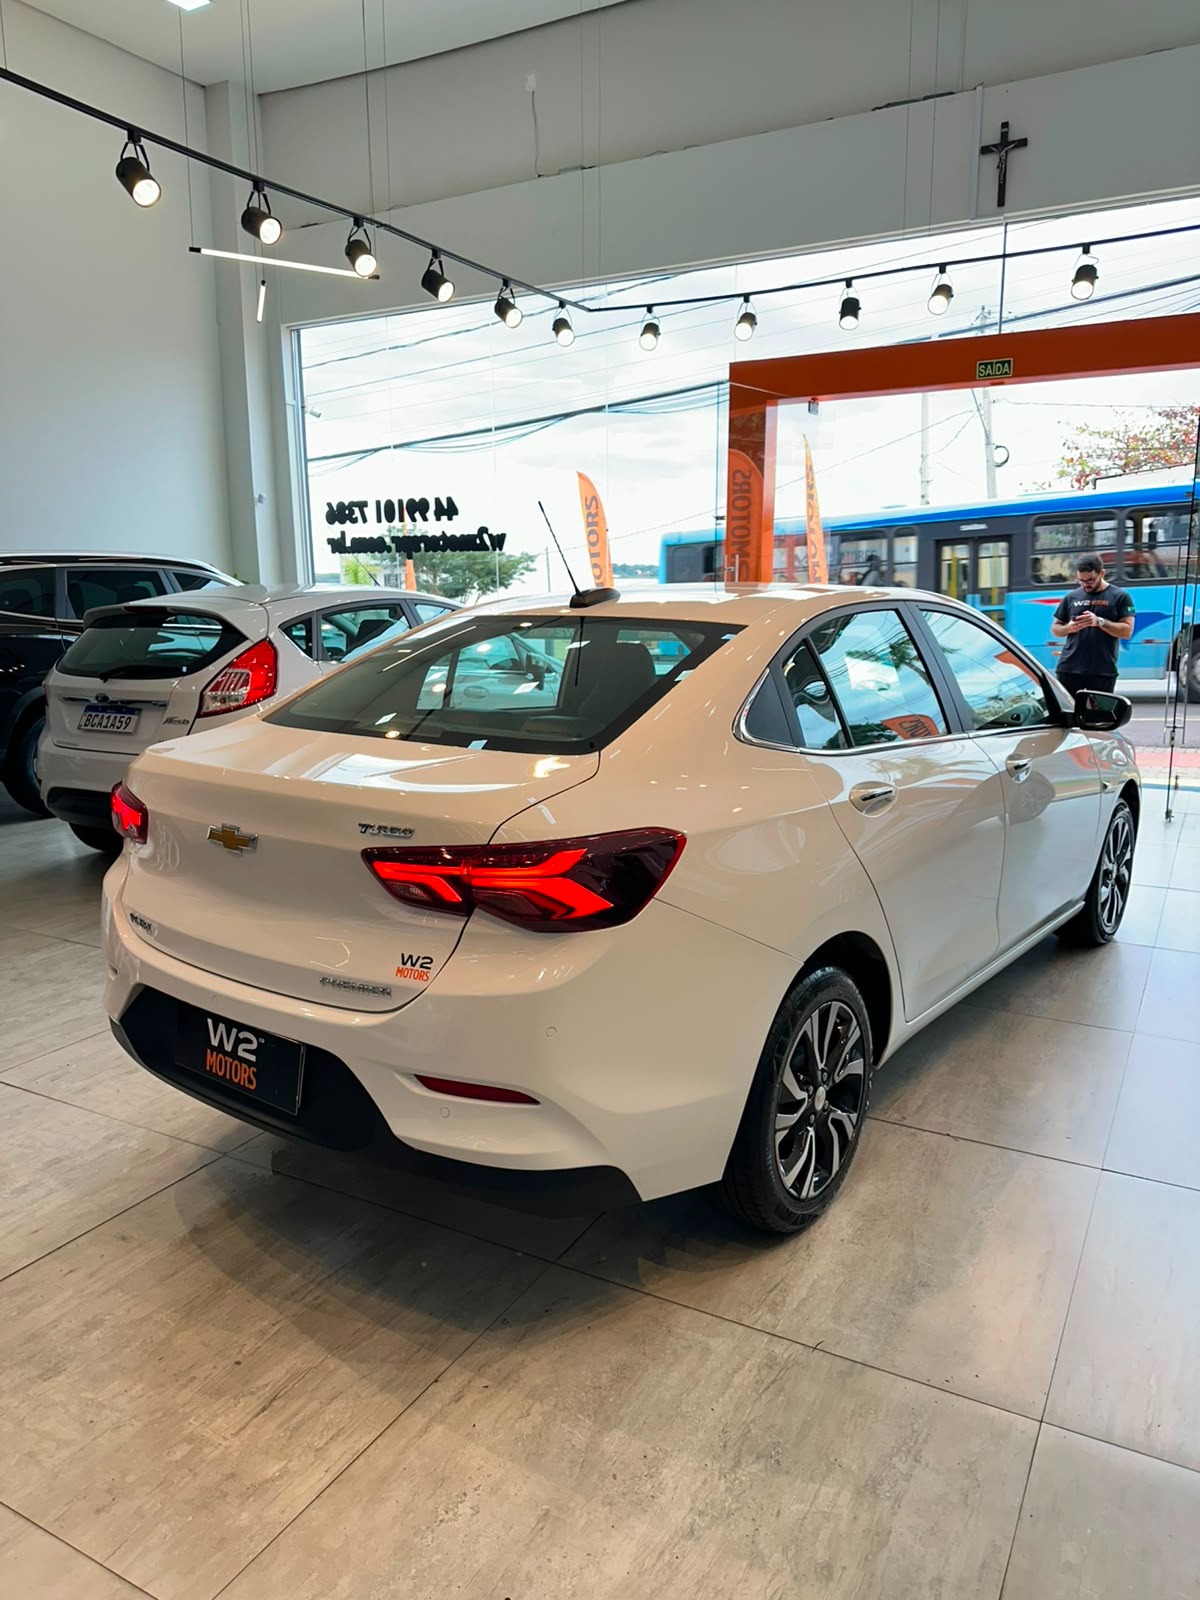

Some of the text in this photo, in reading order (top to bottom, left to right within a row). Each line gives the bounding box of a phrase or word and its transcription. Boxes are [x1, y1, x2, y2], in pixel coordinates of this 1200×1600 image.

[977, 360, 1011, 377] SAÍDA
[83, 713, 132, 730] BCA1A59
[400, 953, 434, 970] W2
[395, 966, 431, 982] MOTORS
[207, 1017, 259, 1063] W2
[205, 1047, 258, 1091] MOTORS
